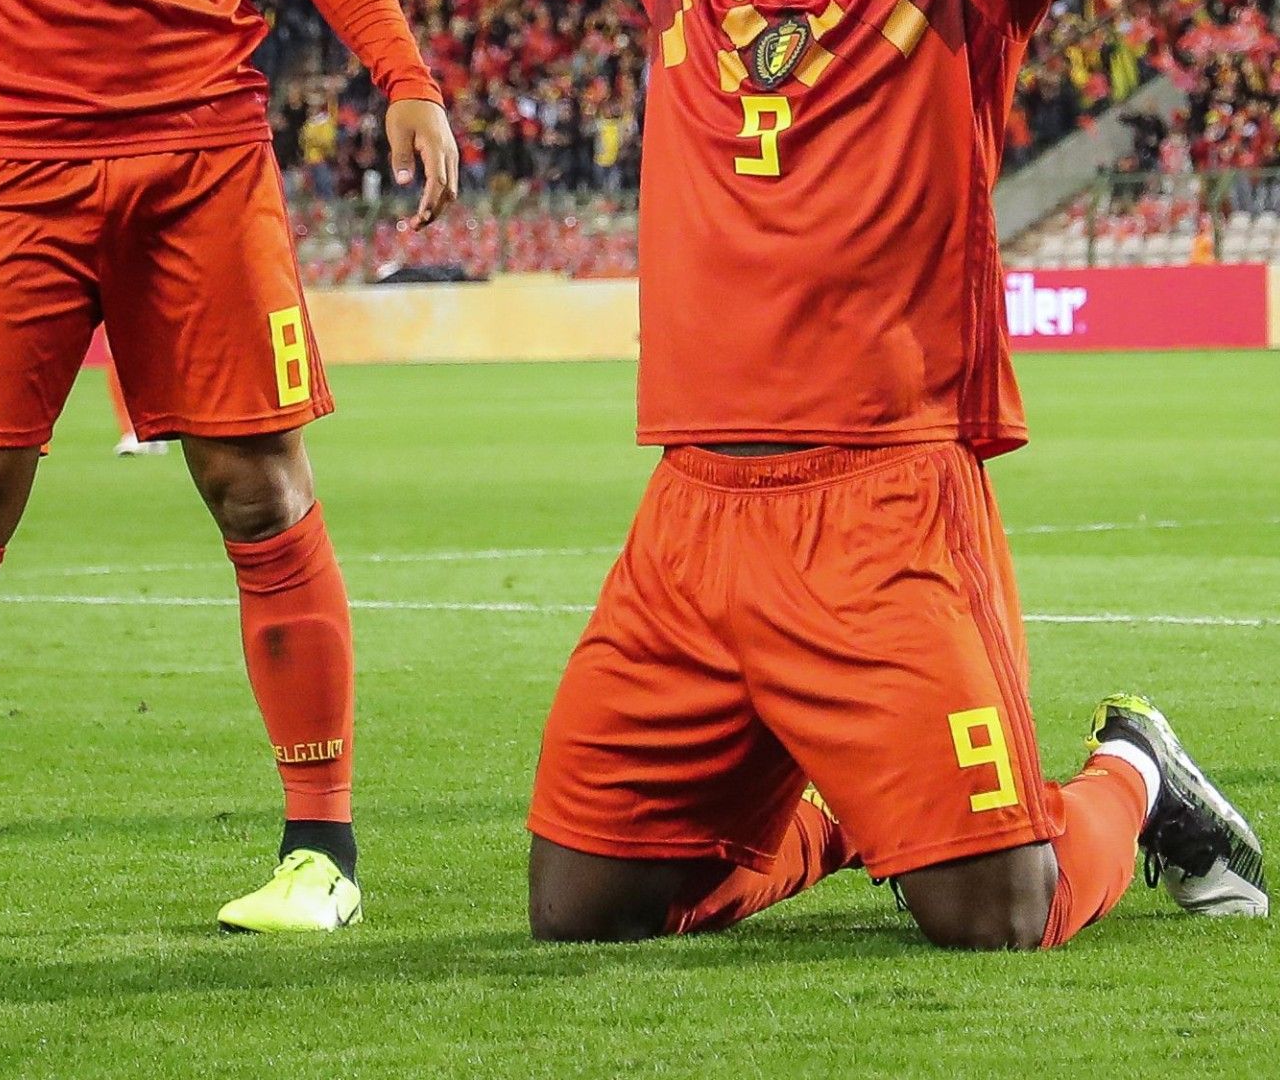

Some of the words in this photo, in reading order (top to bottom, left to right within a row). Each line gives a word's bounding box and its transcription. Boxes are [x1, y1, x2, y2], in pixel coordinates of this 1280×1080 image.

[734, 95, 793, 177] 9
[268, 305, 311, 408] 8
[948, 706, 1018, 813] 9
